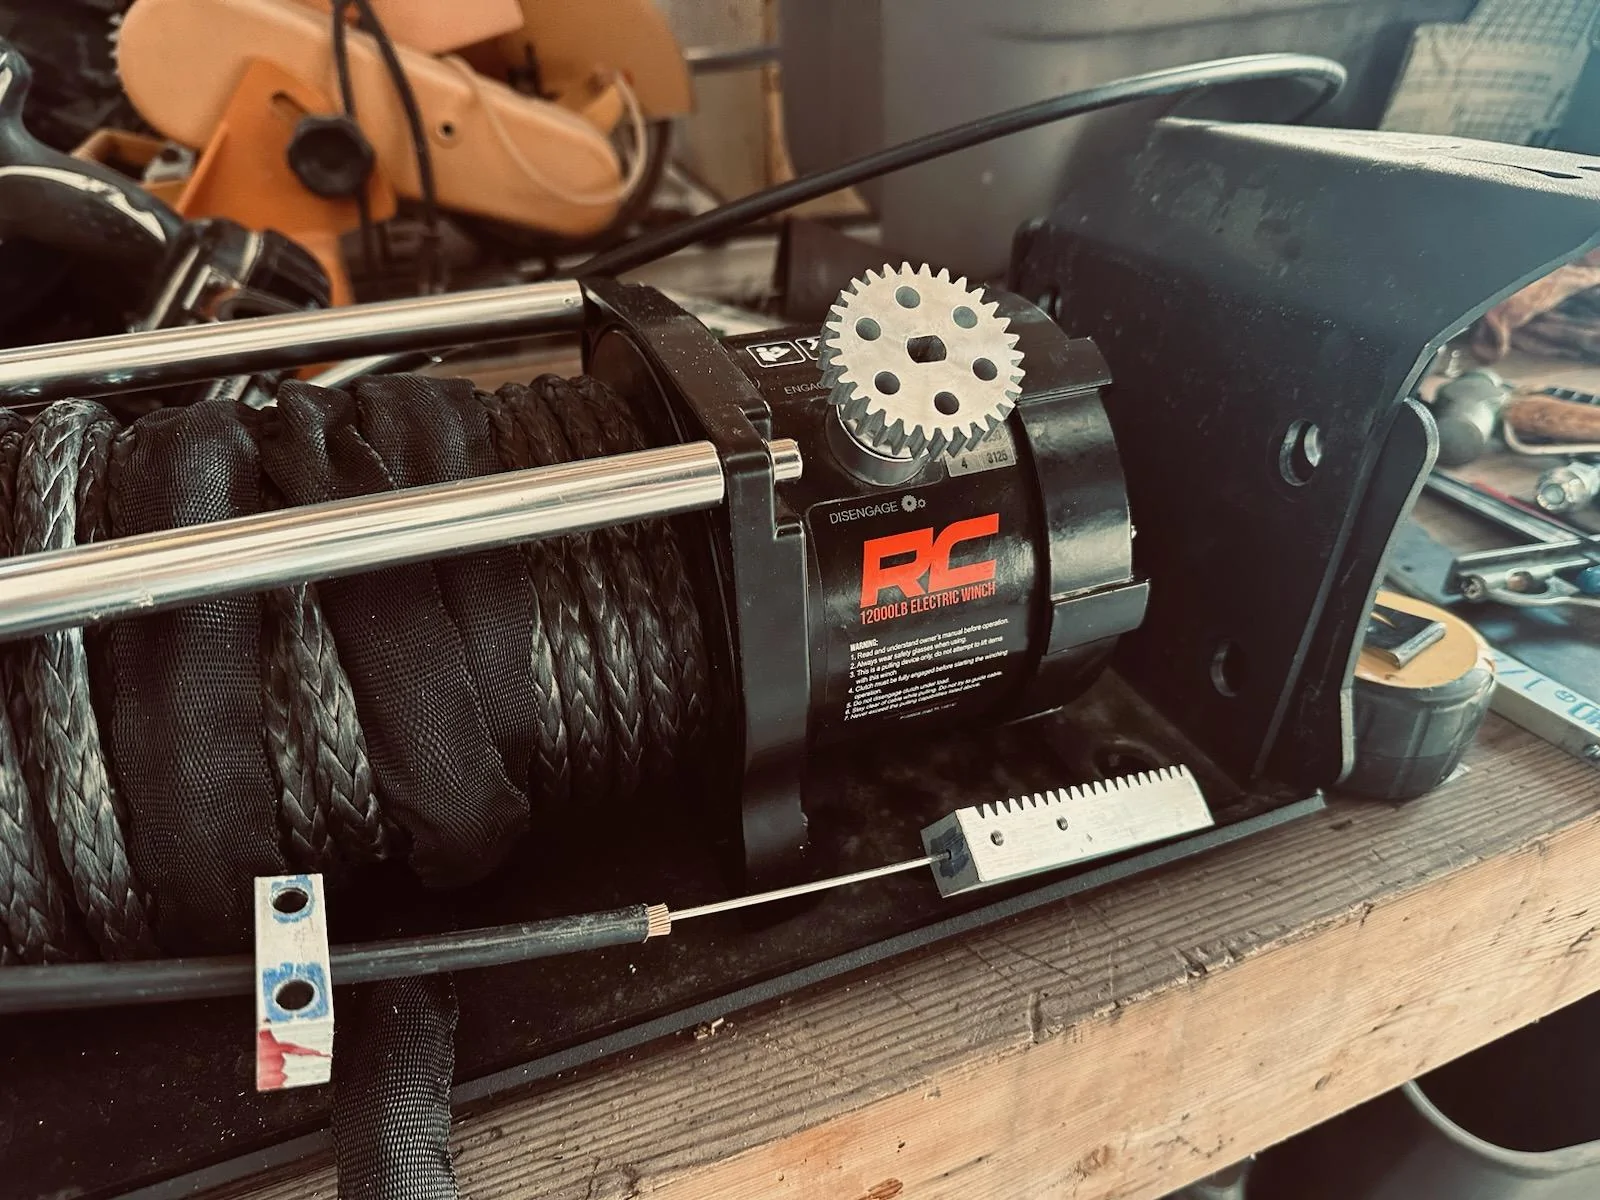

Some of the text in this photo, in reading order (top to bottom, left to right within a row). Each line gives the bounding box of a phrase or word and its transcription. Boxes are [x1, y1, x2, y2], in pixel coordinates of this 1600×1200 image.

[829, 501, 899, 524] DISENGAGE
[860, 512, 999, 609] RC
[860, 581, 997, 625] 12000LB ELECTRIC WINCH
[850, 638, 878, 652] WARNING:
[857, 650, 874, 660] Read
[874, 646, 886, 656] and
[886, 638, 919, 653] understand
[919, 633, 942, 645] owner's
[942, 627, 964, 639] manual
[964, 624, 982, 634] before
[856, 658, 878, 669] Always
[878, 654, 893, 663] wear
[893, 650, 912, 660] safety
[912, 644, 934, 657] glasses
[934, 641, 950, 650] when
[856, 668, 870, 677] This
[881, 661, 901, 671] pulling
[900, 656, 920, 666] device
[943, 647, 953, 656] not
[952, 642, 974, 653] attempt
[987, 635, 1003, 644] items
[855, 683, 874, 693] Clutch
[874, 678, 889, 688] must
[897, 673, 910, 682] fully
[910, 666, 935, 679] engaged
[935, 662, 954, 673] before
[953, 658, 975, 668] starting
[984, 649, 1009, 660] winching
[855, 676, 869, 685] with
[869, 673, 880, 682] this
[872, 690, 902, 702] disengage
[902, 685, 920, 695] clutch
[919, 680, 936, 690] under
[887, 695, 903, 705] cable
[850, 711, 868, 720] Never
[868, 705, 889, 715] exceed
[898, 698, 918, 708] pulling
